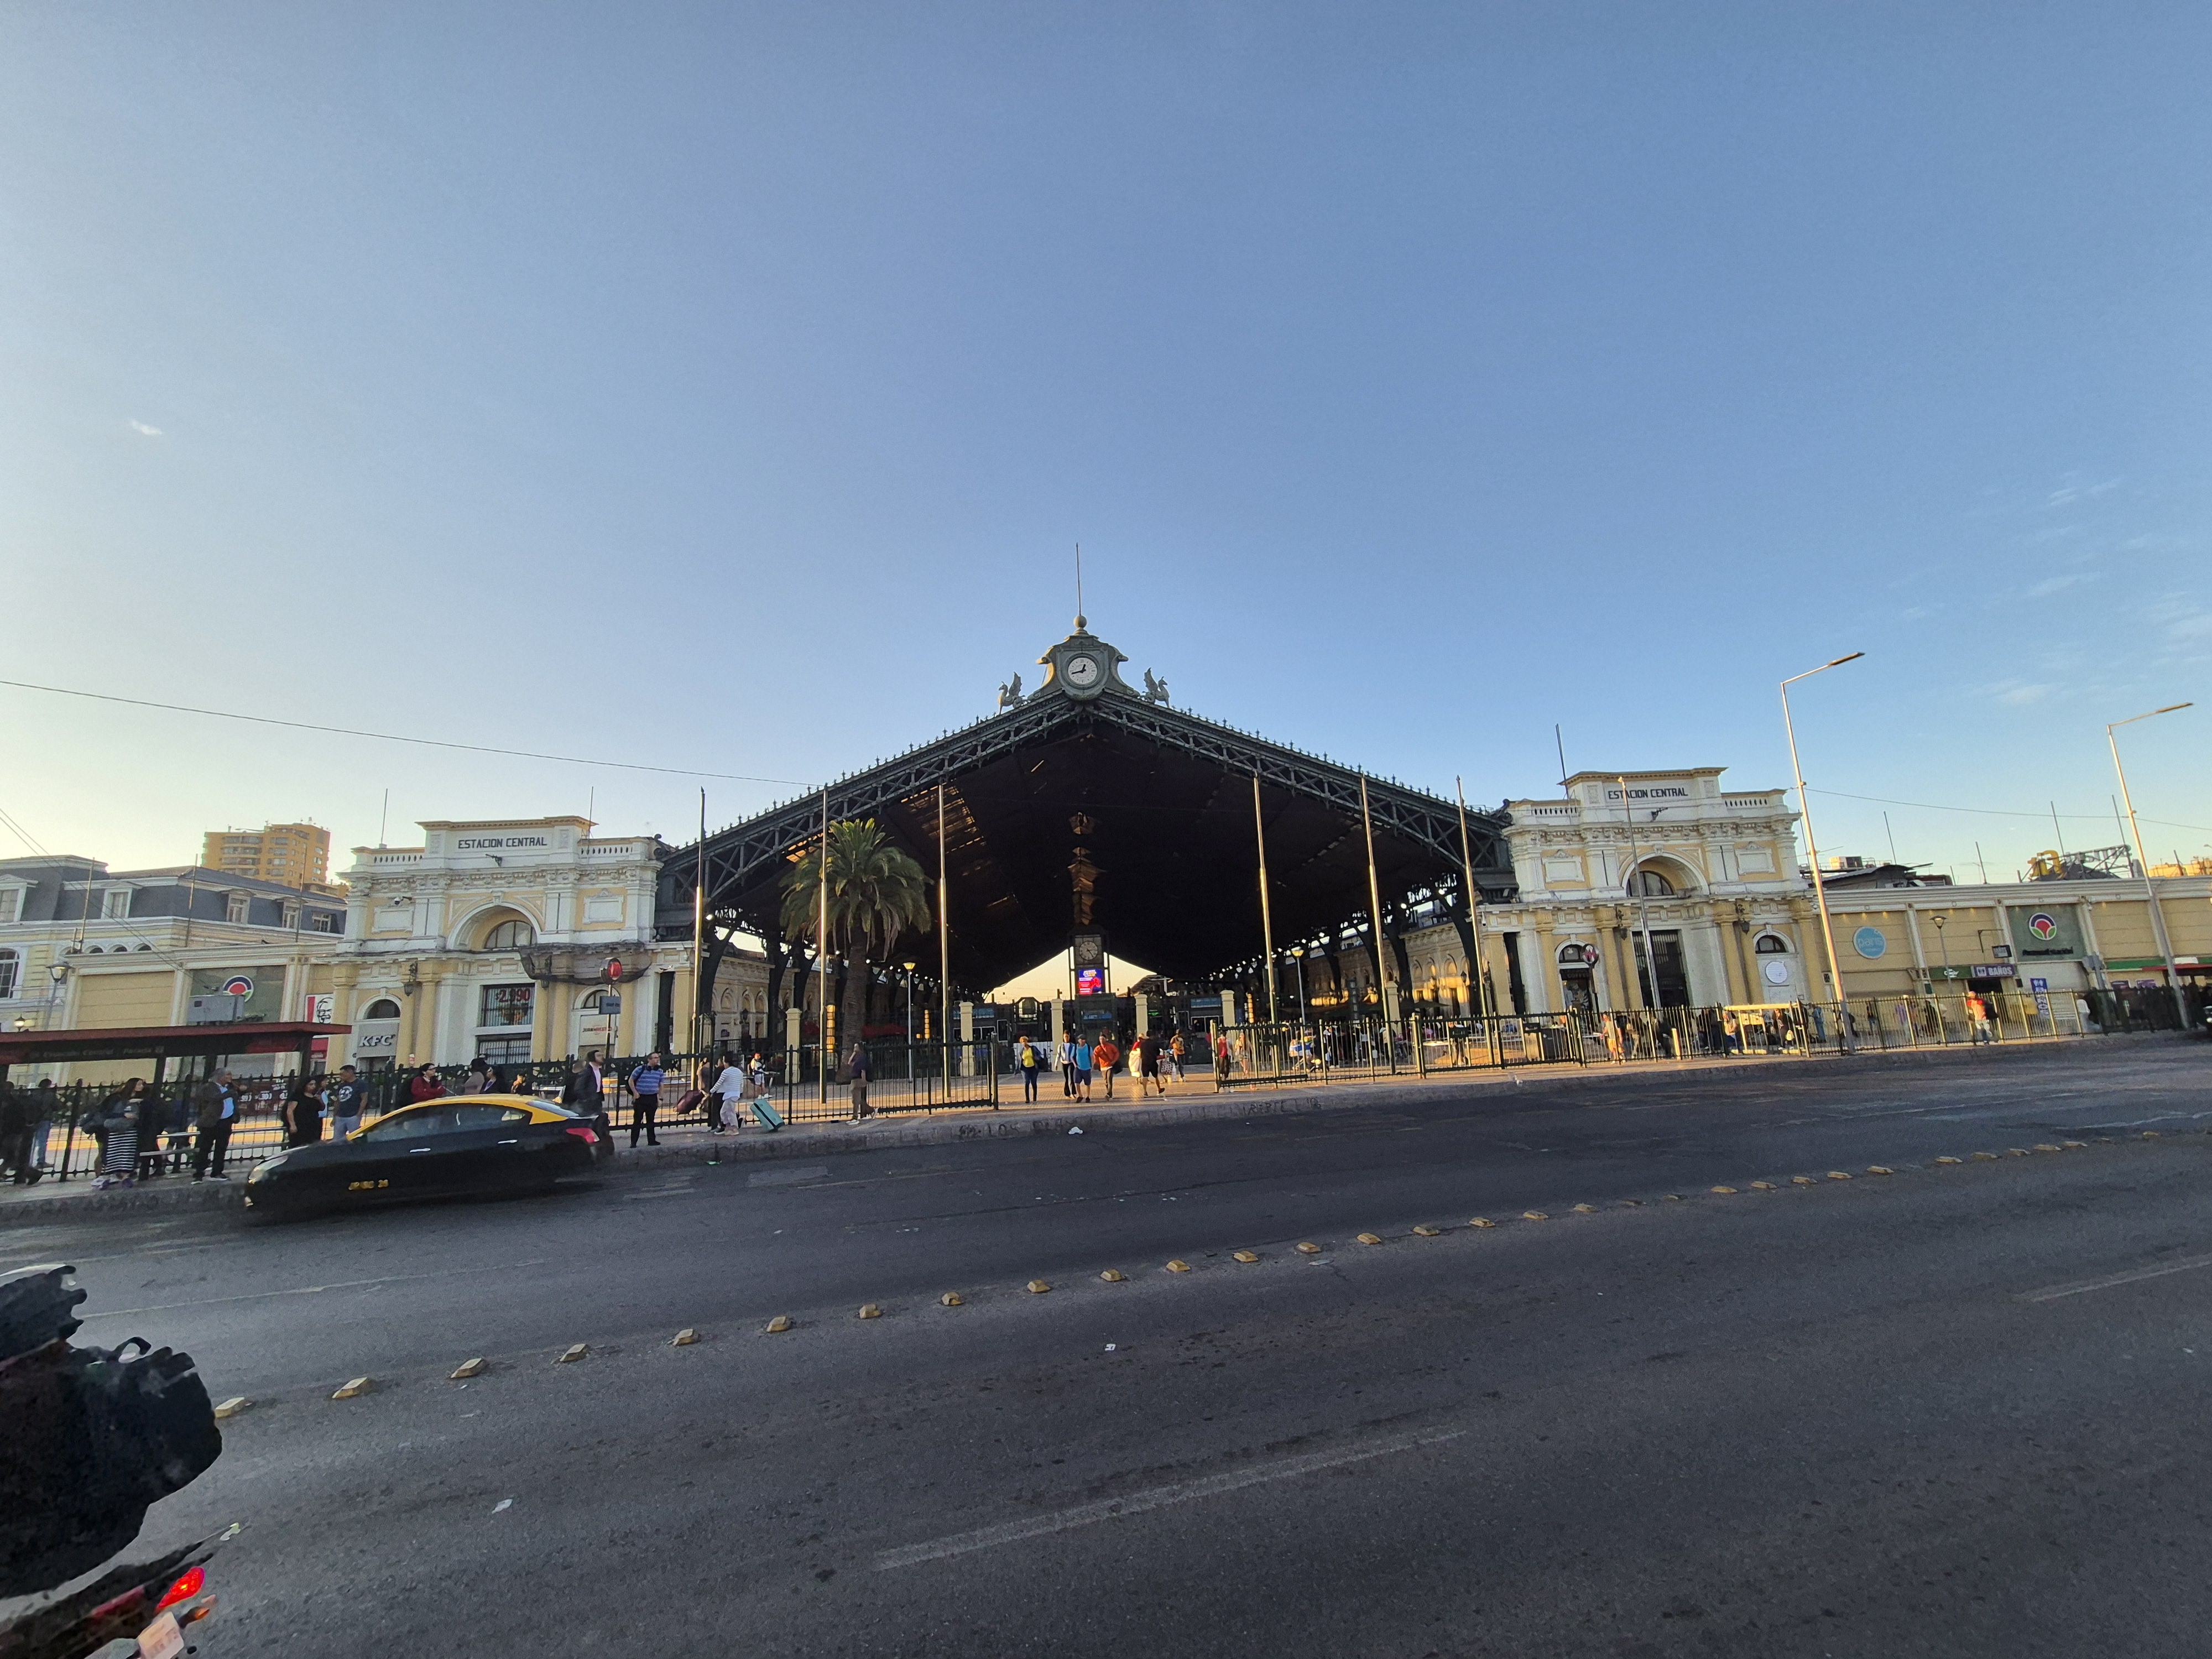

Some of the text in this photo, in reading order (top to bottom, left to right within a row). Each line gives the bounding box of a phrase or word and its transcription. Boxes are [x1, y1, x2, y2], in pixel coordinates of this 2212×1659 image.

[1608, 787, 1688, 799] ESTACION CENTRAL
[458, 837, 547, 849] ESTACION CENTRAL
[1988, 966, 2013, 976] BAÑOS
[359, 1035, 393, 1047] KFC
